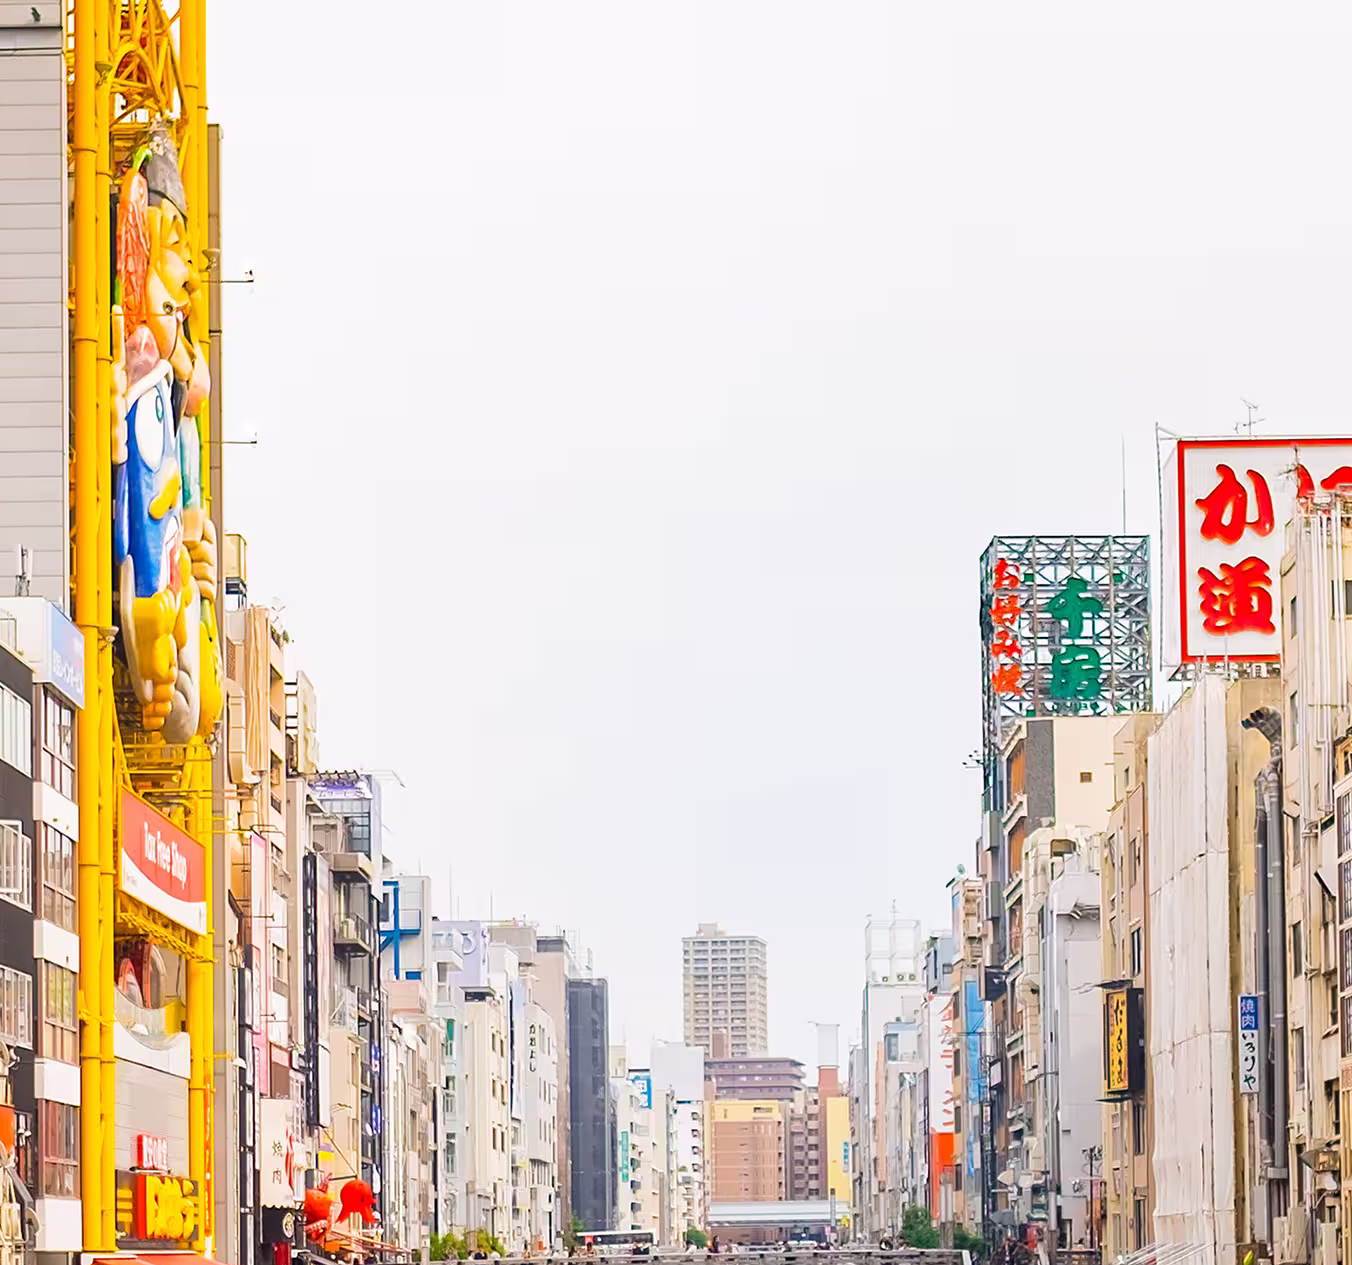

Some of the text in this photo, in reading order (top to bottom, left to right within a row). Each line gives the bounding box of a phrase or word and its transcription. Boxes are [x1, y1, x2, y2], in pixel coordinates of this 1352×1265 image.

[144, 822, 156, 861] Tax
[1241, 999, 1257, 1090] 焼肉 いろりや
